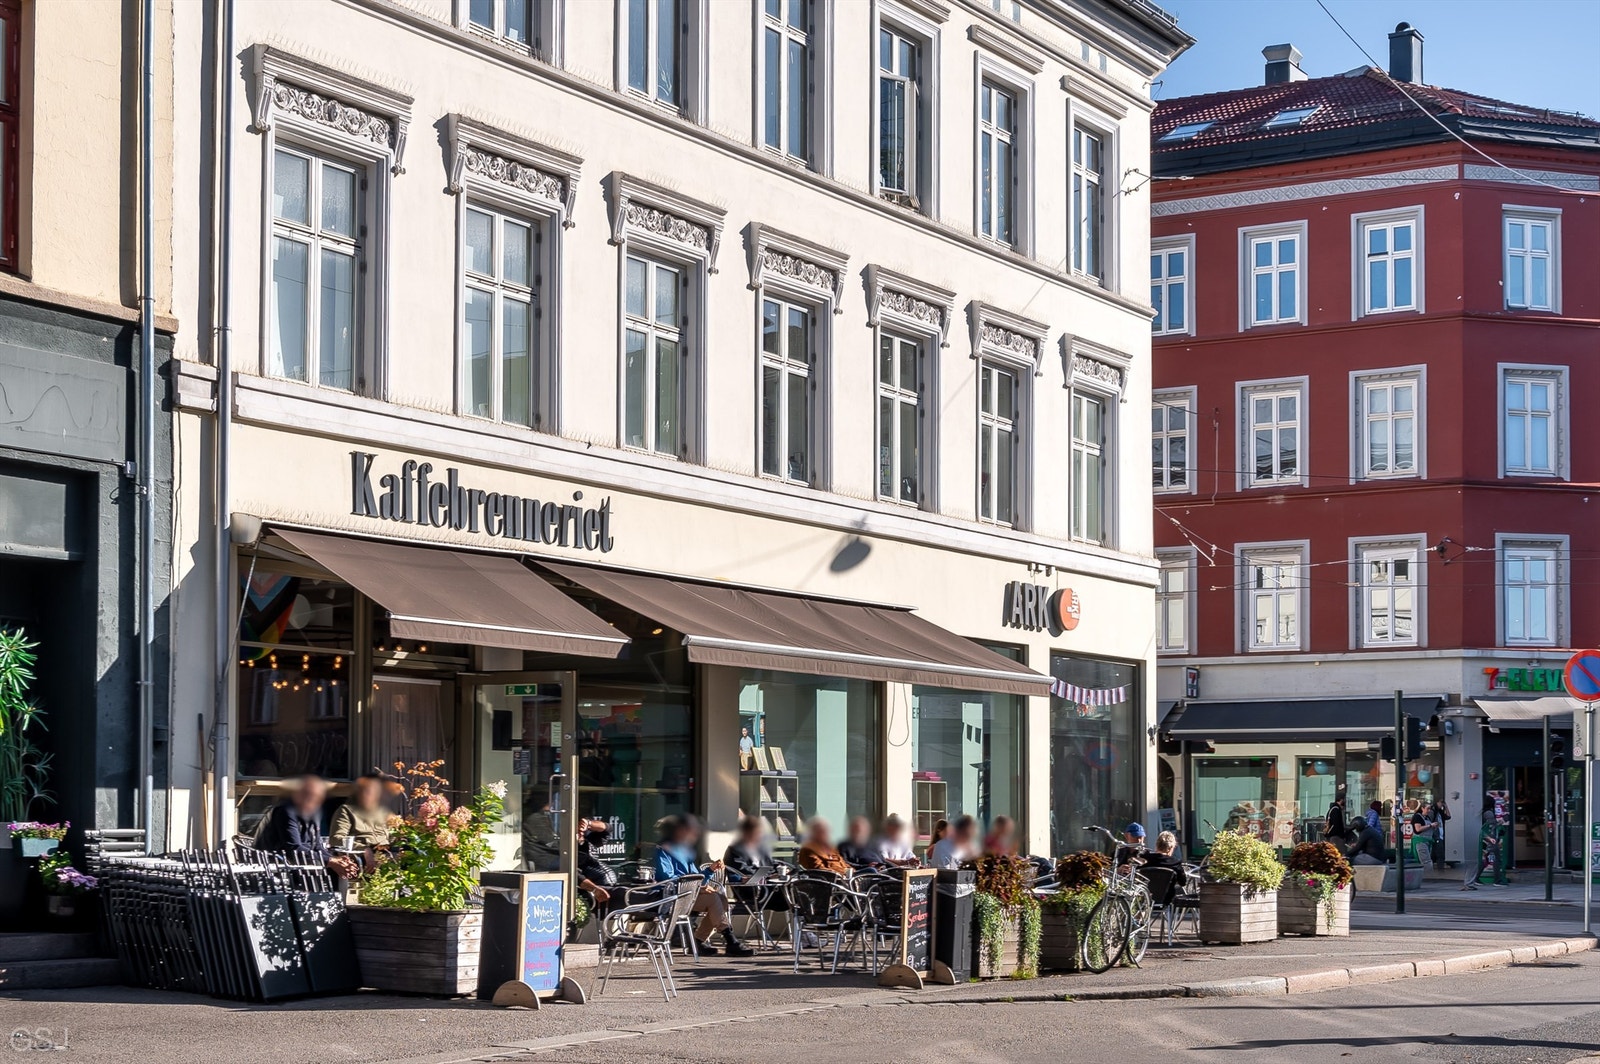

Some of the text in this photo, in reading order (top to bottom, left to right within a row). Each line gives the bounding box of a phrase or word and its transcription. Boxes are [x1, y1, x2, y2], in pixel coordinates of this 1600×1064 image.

[349, 450, 614, 553] Kaffebrenneriet
[1006, 580, 1051, 631] ARK
[1483, 667, 1566, 692] 7-ELEV
[1401, 824, 1414, 836] 19
